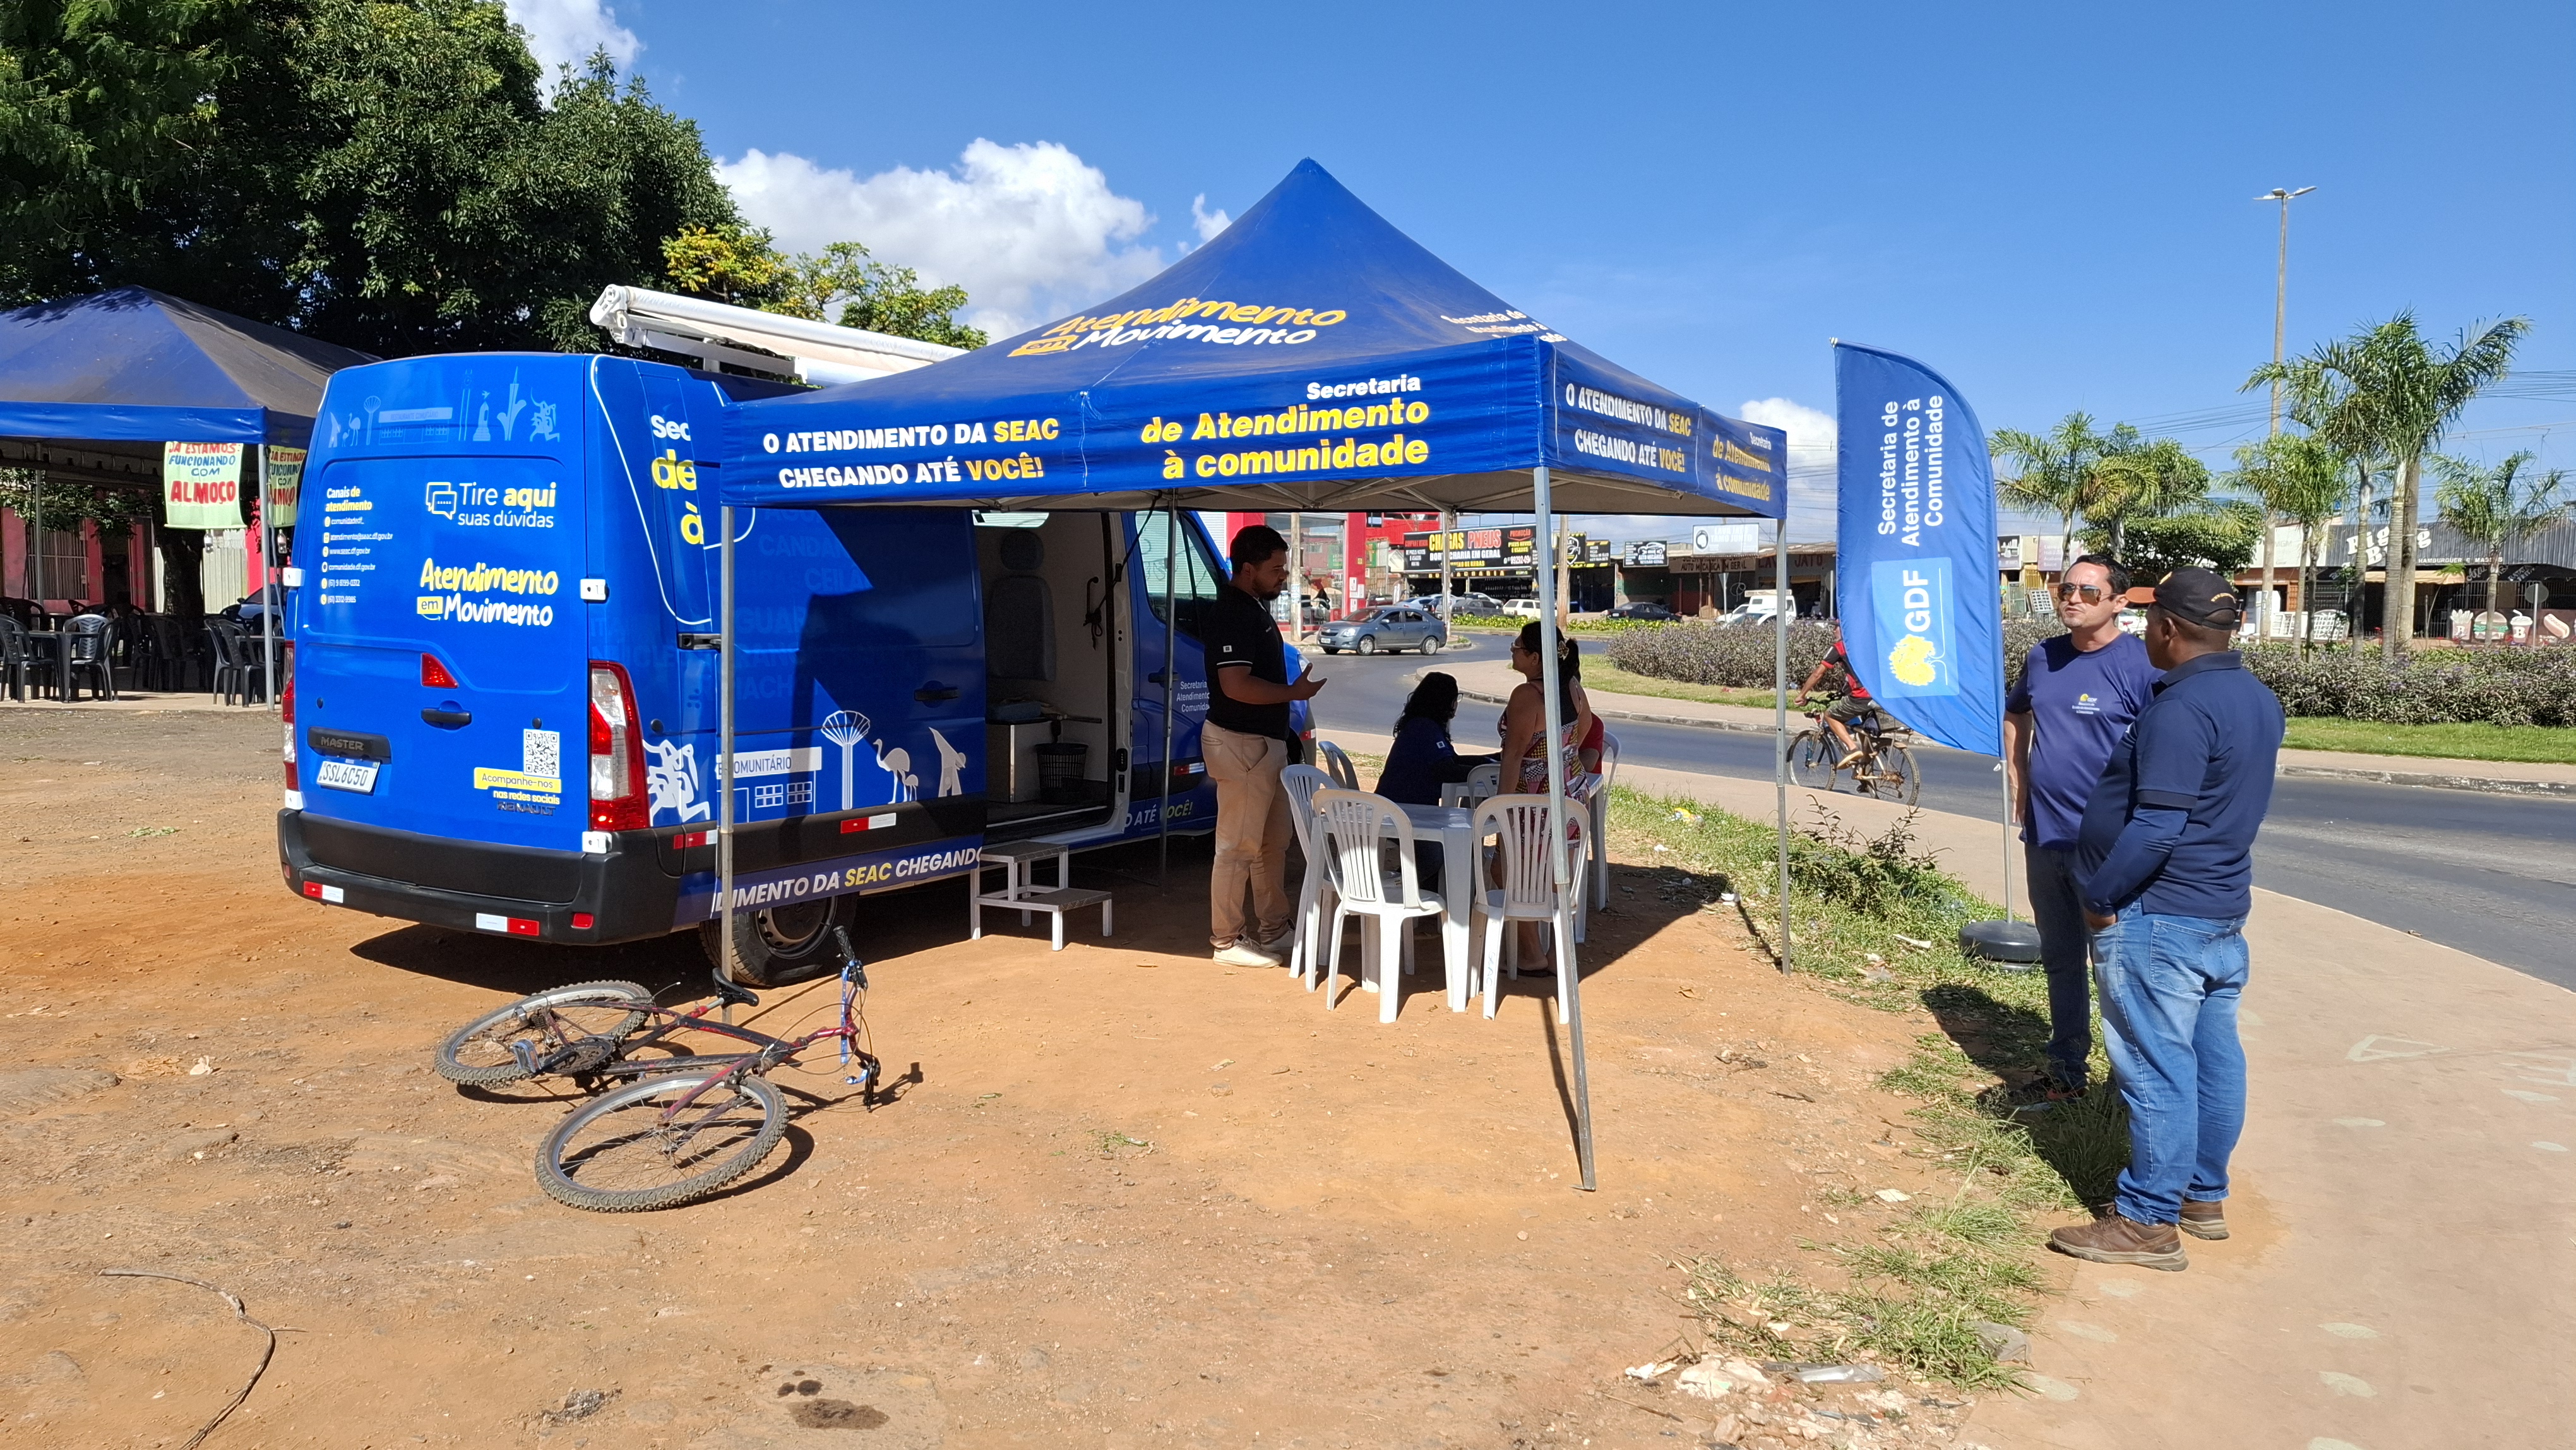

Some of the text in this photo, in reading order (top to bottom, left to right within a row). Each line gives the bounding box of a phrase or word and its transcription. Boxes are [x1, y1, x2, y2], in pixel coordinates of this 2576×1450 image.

[1046, 297, 1349, 337] Atendimento
[1071, 319, 1318, 351] Movimento
[1307, 374, 1421, 400] Secretaria
[1142, 397, 1429, 443] de Atendimento
[1566, 383, 1691, 436] O ATENDIMENTO DA SEAC
[763, 418, 1059, 453] O ATENDIMENTO DA SEAC
[1713, 434, 1724, 459] de
[169, 455, 236, 466] FUNCIONANDO
[1164, 433, 1429, 479] à comunidade
[1575, 428, 1685, 473] CHEGANDO ATÉ VOCÊ!
[1924, 395, 1943, 527] Comunidade
[191, 467, 220, 477] COM
[778, 452, 1044, 488] CHEGANDO ATÉ VOCÊ!
[1878, 400, 1899, 536] Secretaria de
[1902, 397, 1921, 548] Atendimento à
[170, 480, 236, 505] ALMOÇO
[327, 486, 361, 498] Canais de
[460, 482, 556, 511] Tire aqui
[325, 500, 373, 512] atendimento
[458, 510, 554, 529] suas dúvidas
[1467, 529, 1501, 549] PNEUS
[1472, 550, 1480, 558] EM
[1481, 549, 1501, 559] GERAL
[1681, 563, 1693, 571] AUTO
[420, 557, 559, 596] Atendimento
[421, 593, 553, 626] em Movimento
[1903, 569, 1930, 633] GDF
[1180, 680, 1207, 690] Secretaria
[321, 737, 364, 751] MASTER
[323, 764, 368, 787] SSL6C50
[734, 754, 792, 774] OMUNITÁRIO
[482, 773, 553, 789] Acompanhe-nos
[493, 791, 560, 805] nas redes sociais
[497, 801, 556, 817] RENAULT
[1134, 804, 1157, 826] ATÉ
[1160, 799, 1193, 821] OCÊ!
[813, 872, 840, 894] DA
[845, 863, 892, 887] SEAC
